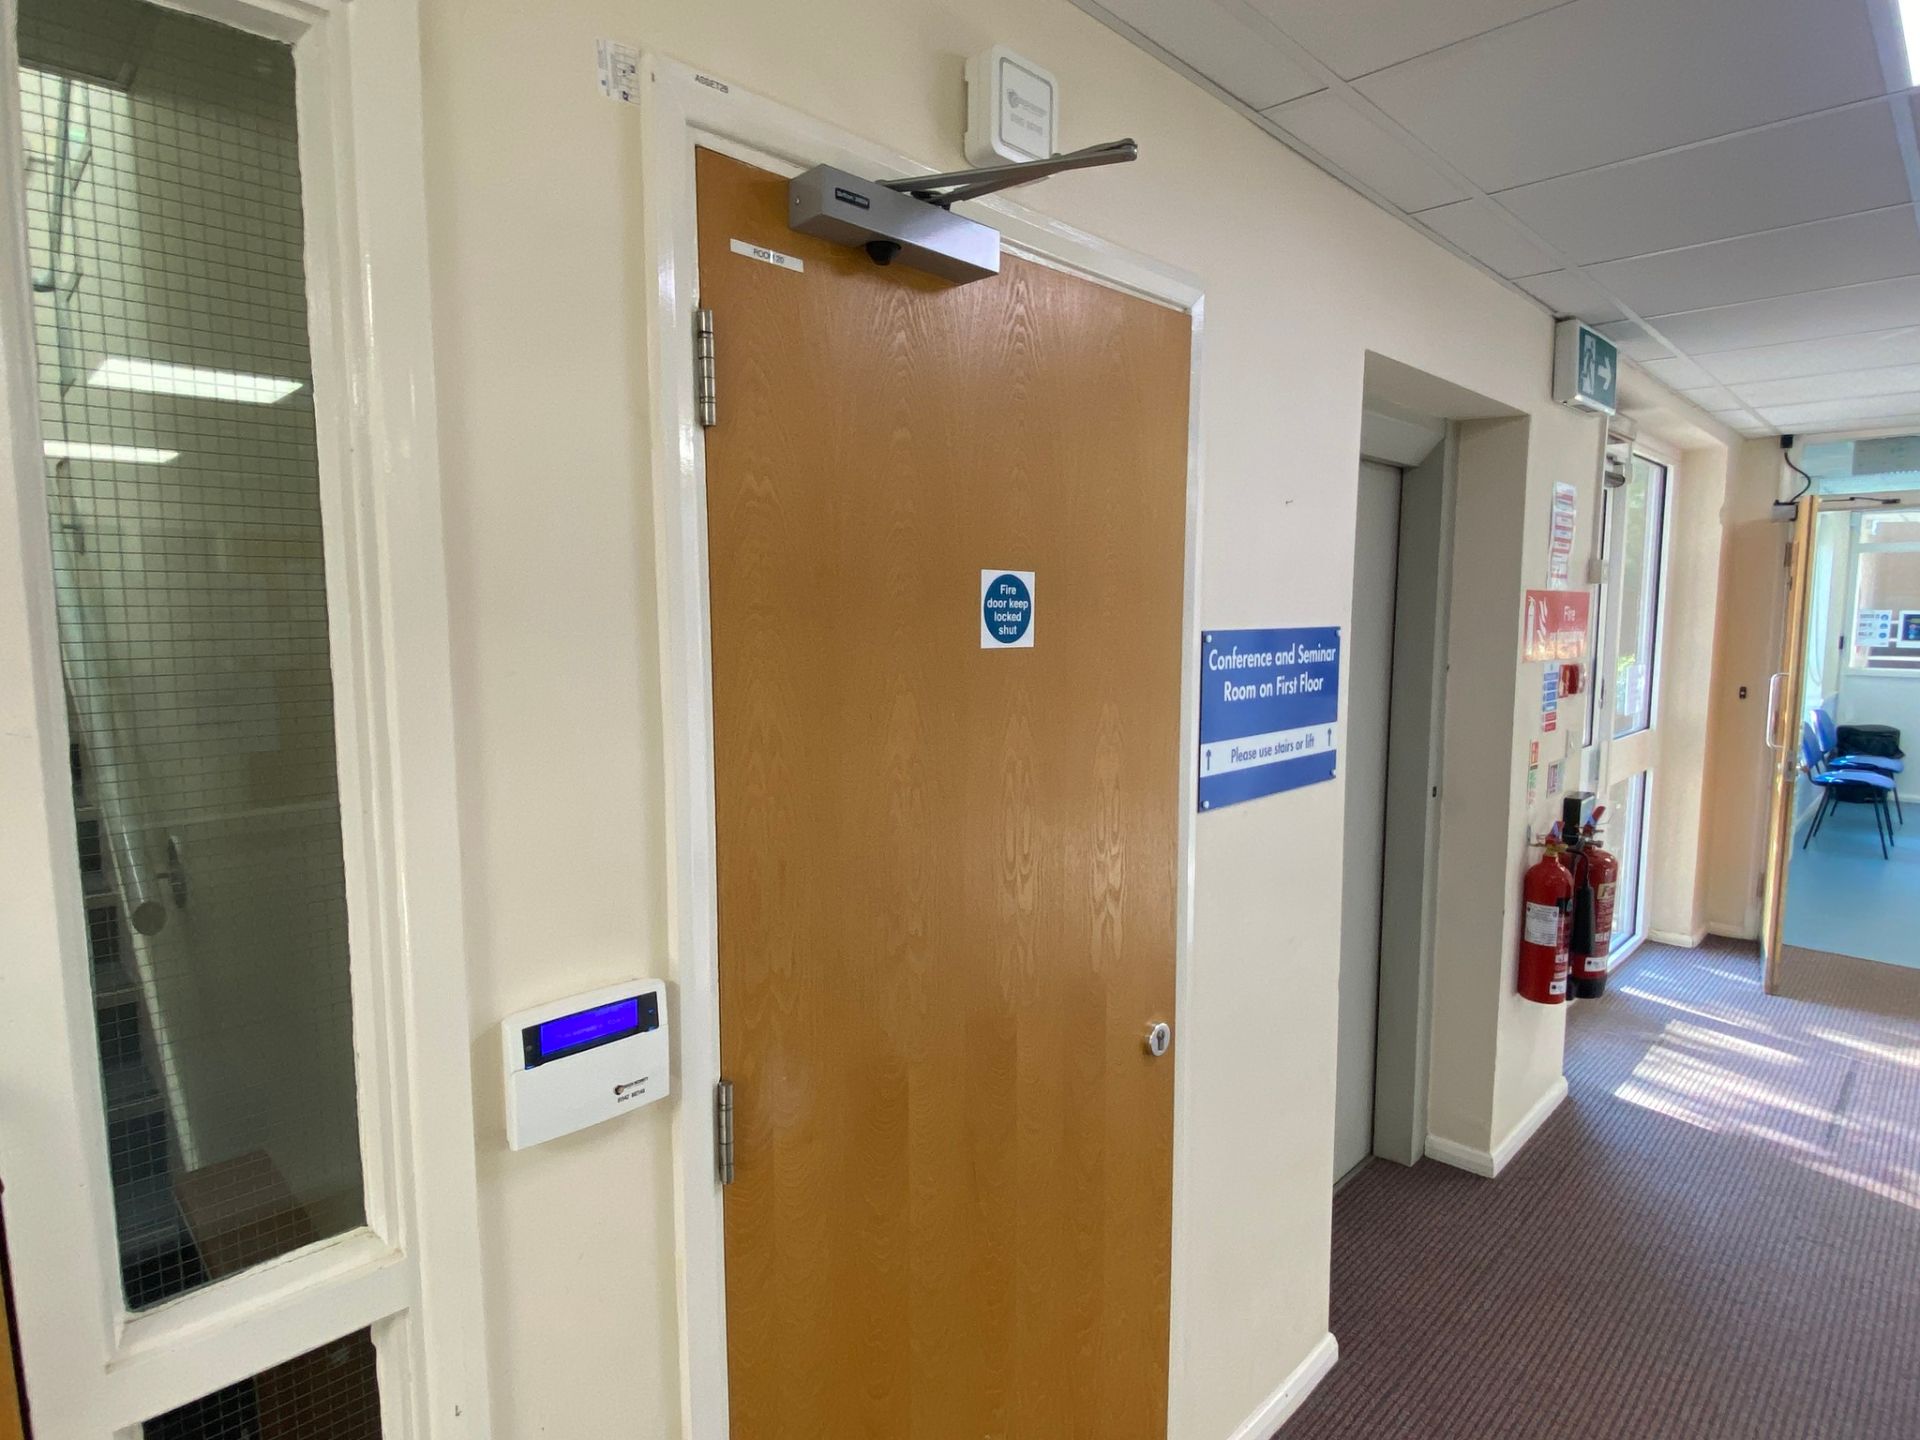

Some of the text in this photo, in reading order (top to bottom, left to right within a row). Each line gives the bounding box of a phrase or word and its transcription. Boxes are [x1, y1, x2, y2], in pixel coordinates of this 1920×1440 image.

[1000, 584, 1017, 595] Fire
[987, 597, 1029, 611] door keep
[994, 611, 1022, 622] locked
[998, 625, 1017, 635] shut
[1209, 643, 1336, 671] Conference and Seminar
[1224, 672, 1324, 702] Room on First Floor
[1231, 733, 1315, 763] Please use stairs or lift
